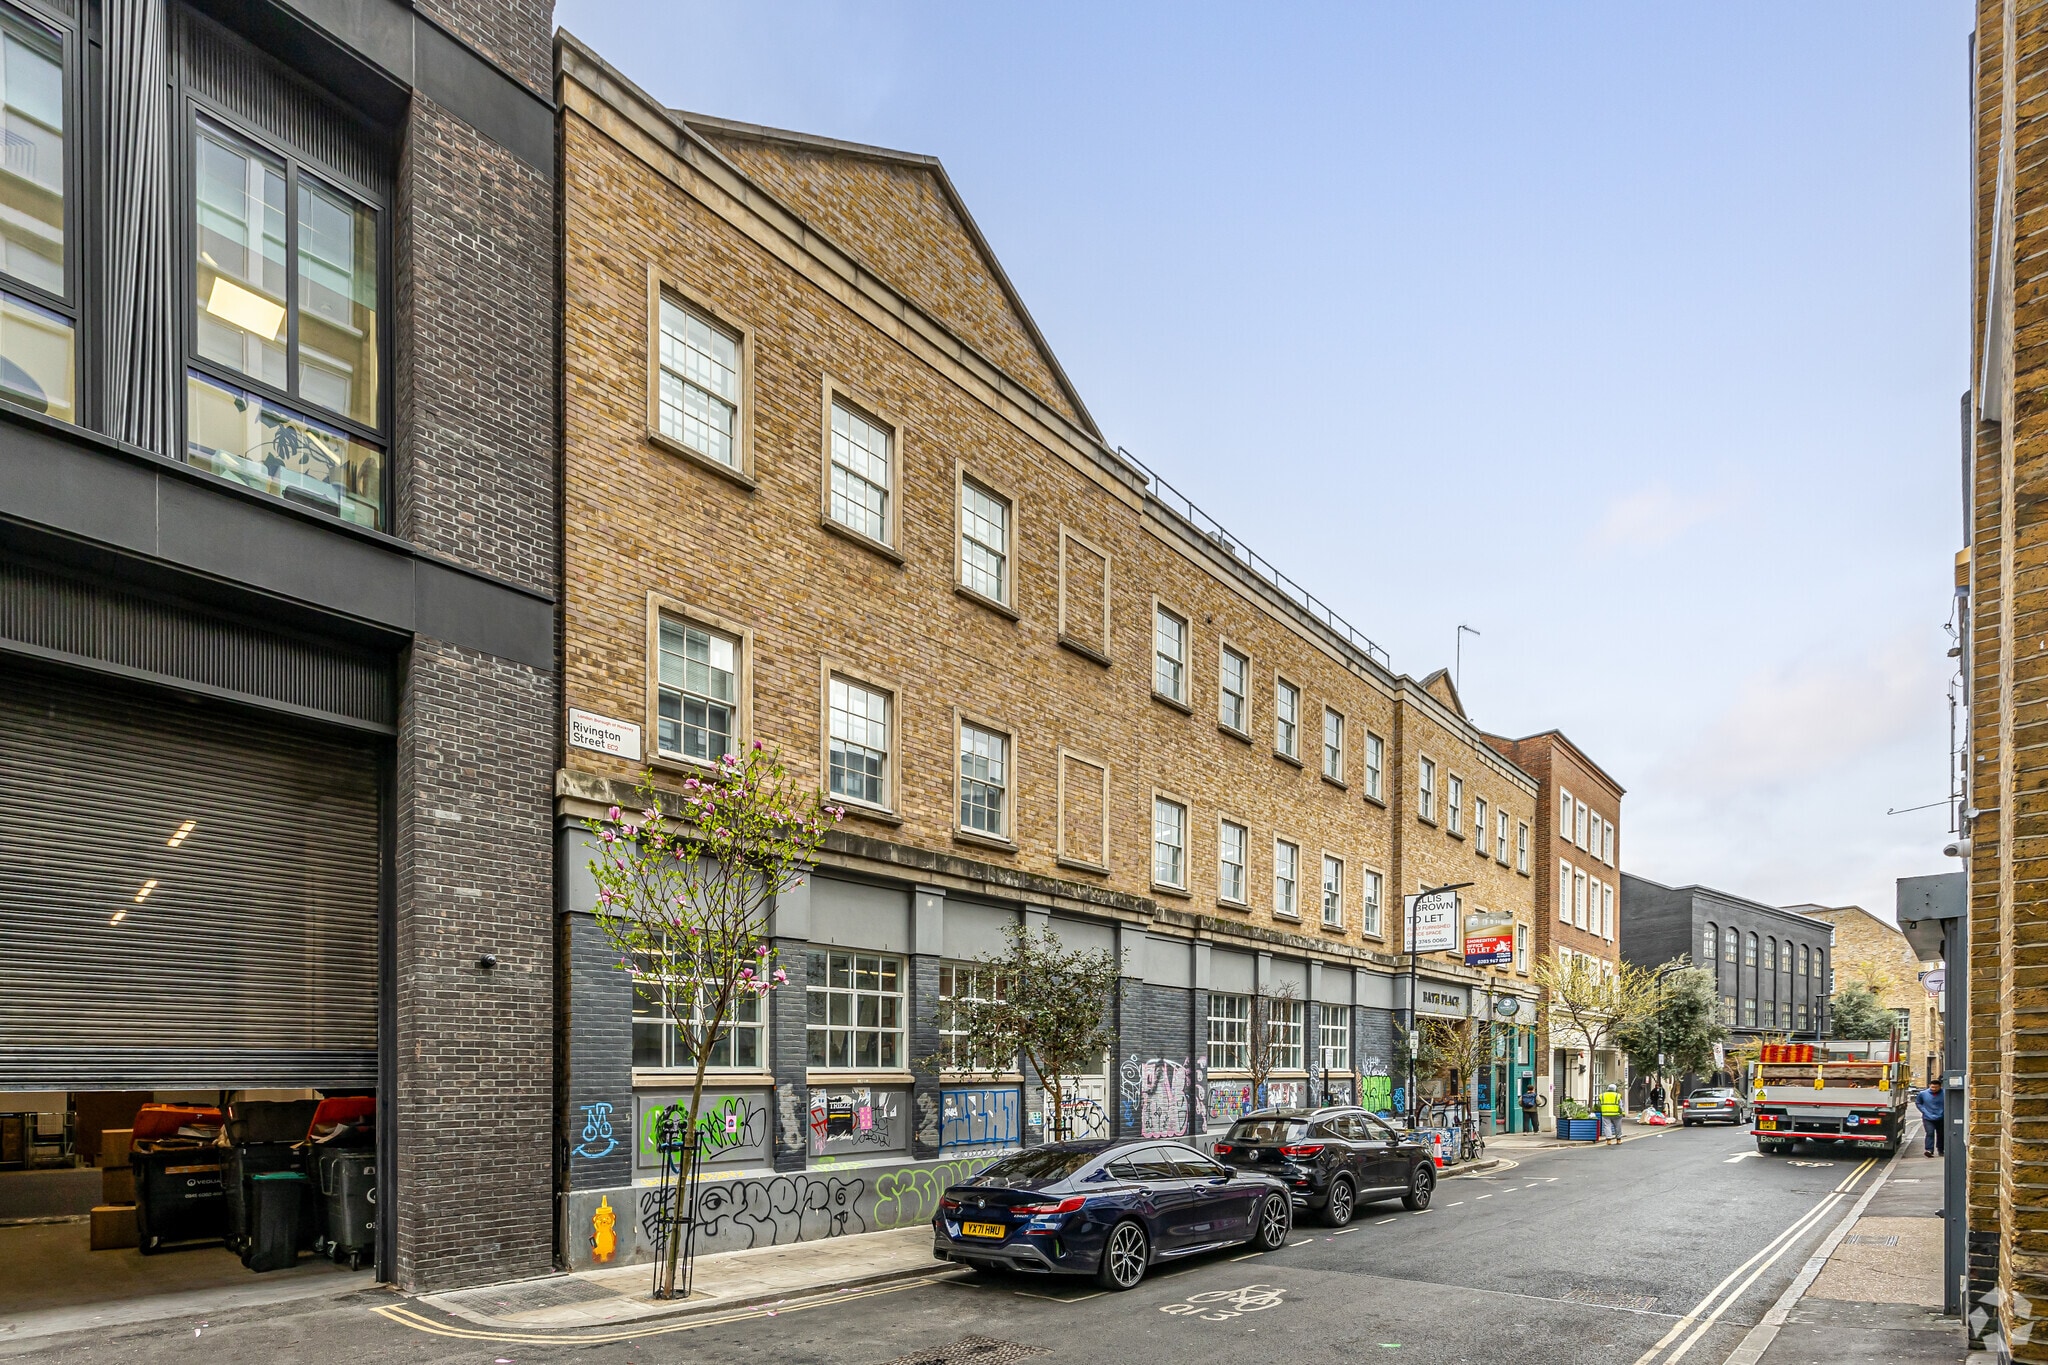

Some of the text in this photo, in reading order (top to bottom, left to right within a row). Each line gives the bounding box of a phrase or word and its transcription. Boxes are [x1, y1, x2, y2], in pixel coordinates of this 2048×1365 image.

[573, 721, 621, 742] Rivington
[573, 732, 619, 752] Street EC2
[1416, 902, 1454, 912] BROWN
[1407, 913, 1444, 924] TO LET
[1760, 1135, 1785, 1143] Bevan
[1857, 1139, 1885, 1148] Bevan
[968, 1223, 985, 1234] YX71
